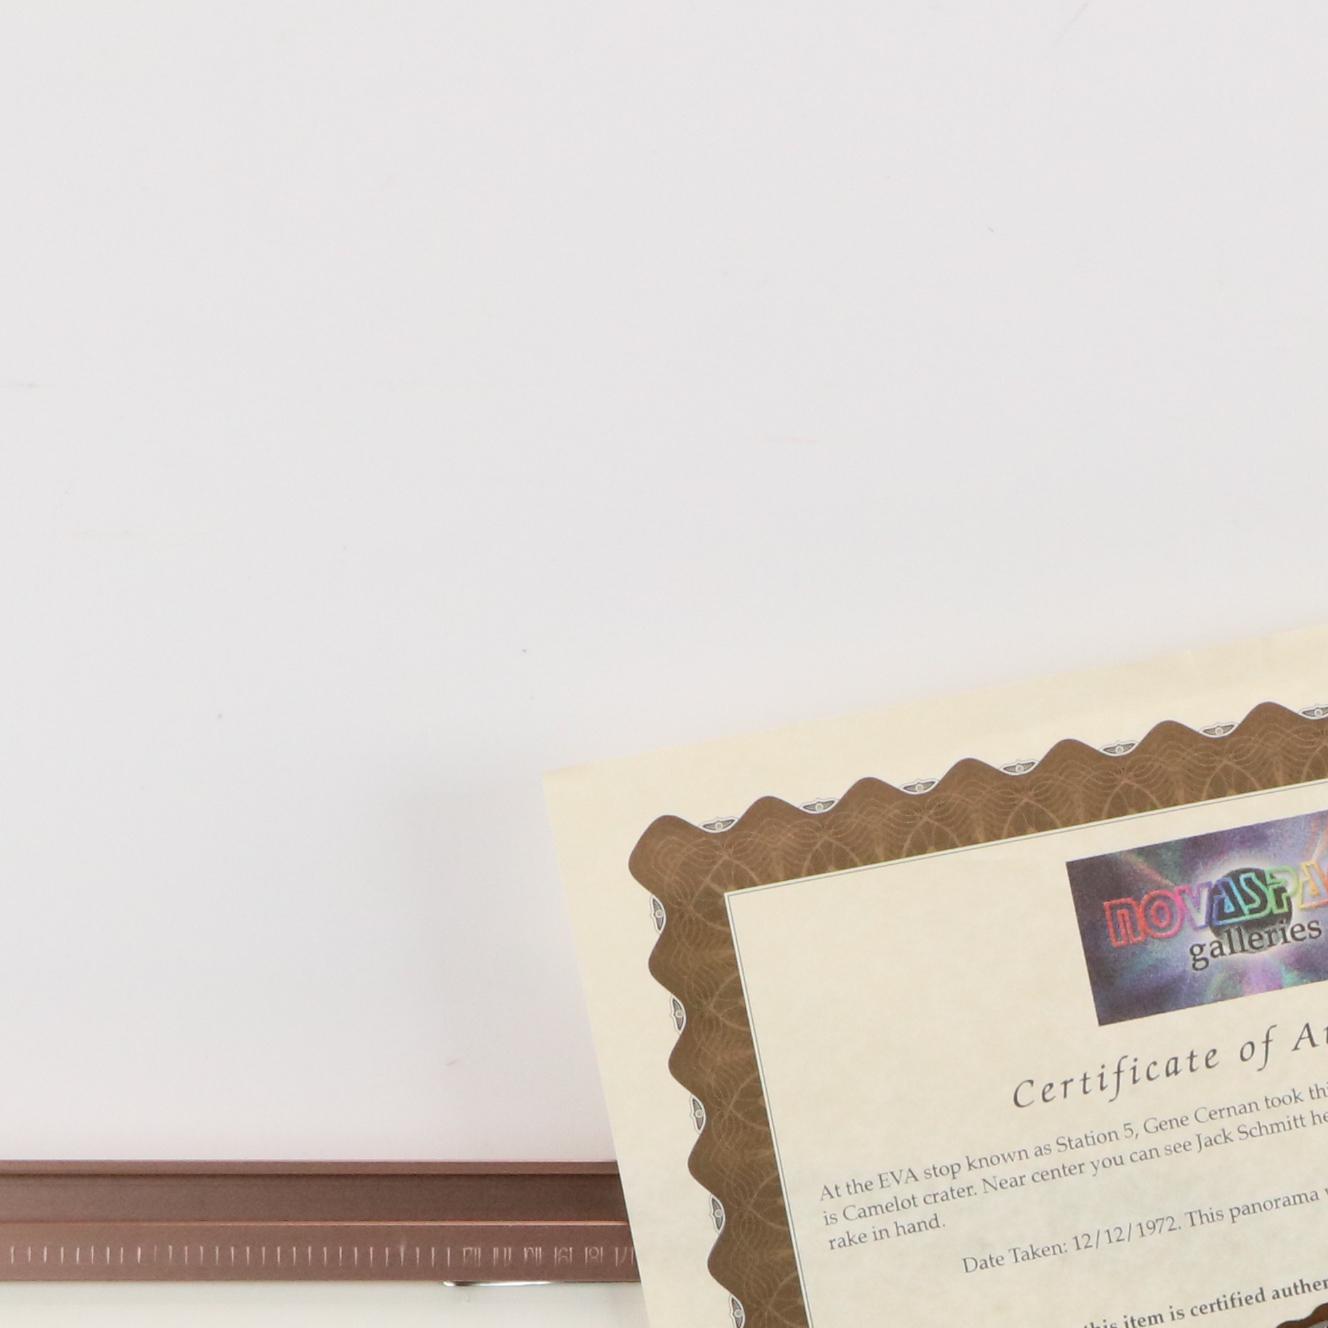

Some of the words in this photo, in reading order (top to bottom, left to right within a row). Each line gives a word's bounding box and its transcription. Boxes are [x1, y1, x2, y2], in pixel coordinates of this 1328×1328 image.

[1189, 919, 1322, 971] galleries
[1012, 1047, 1219, 1109] Certificate
[1238, 1023, 1278, 1072] of
[819, 1183, 842, 1201] At
[844, 1177, 874, 1196] the
[876, 1166, 920, 1190] EVA
[922, 1161, 962, 1181] stop
[964, 1147, 1030, 1172] known
[1032, 1142, 1053, 1158] as
[1054, 1129, 1120, 1153] Station
[1122, 1121, 1139, 1140] 5,
[1142, 1114, 1190, 1134] Gene
[1192, 1100, 1261, 1124] Cernan
[1263, 1086, 1304, 1110] took
[822, 1209, 839, 1226] is
[841, 1193, 919, 1221] Camelot
[921, 1183, 977, 1206] crater.
[980, 1173, 1027, 1194] Near
[1030, 1161, 1086, 1183] center
[1088, 1153, 1125, 1177] you
[1128, 1146, 1161, 1163] can
[1163, 1139, 1192, 1156] see
[1194, 1126, 1234, 1153] Jack
[1235, 1112, 1307, 1141] Schmitt
[827, 1229, 868, 1251] rake
[871, 1225, 891, 1242] in
[892, 1211, 946, 1237] hand.
[960, 1253, 1006, 1274] Date
[1007, 1241, 1068, 1264] Taken:
[1183, 1206, 1225, 1227] This
[1227, 1189, 1320, 1224] panorama
[1167, 1304, 1186, 1322] is
[1188, 1285, 1266, 1317] certified
